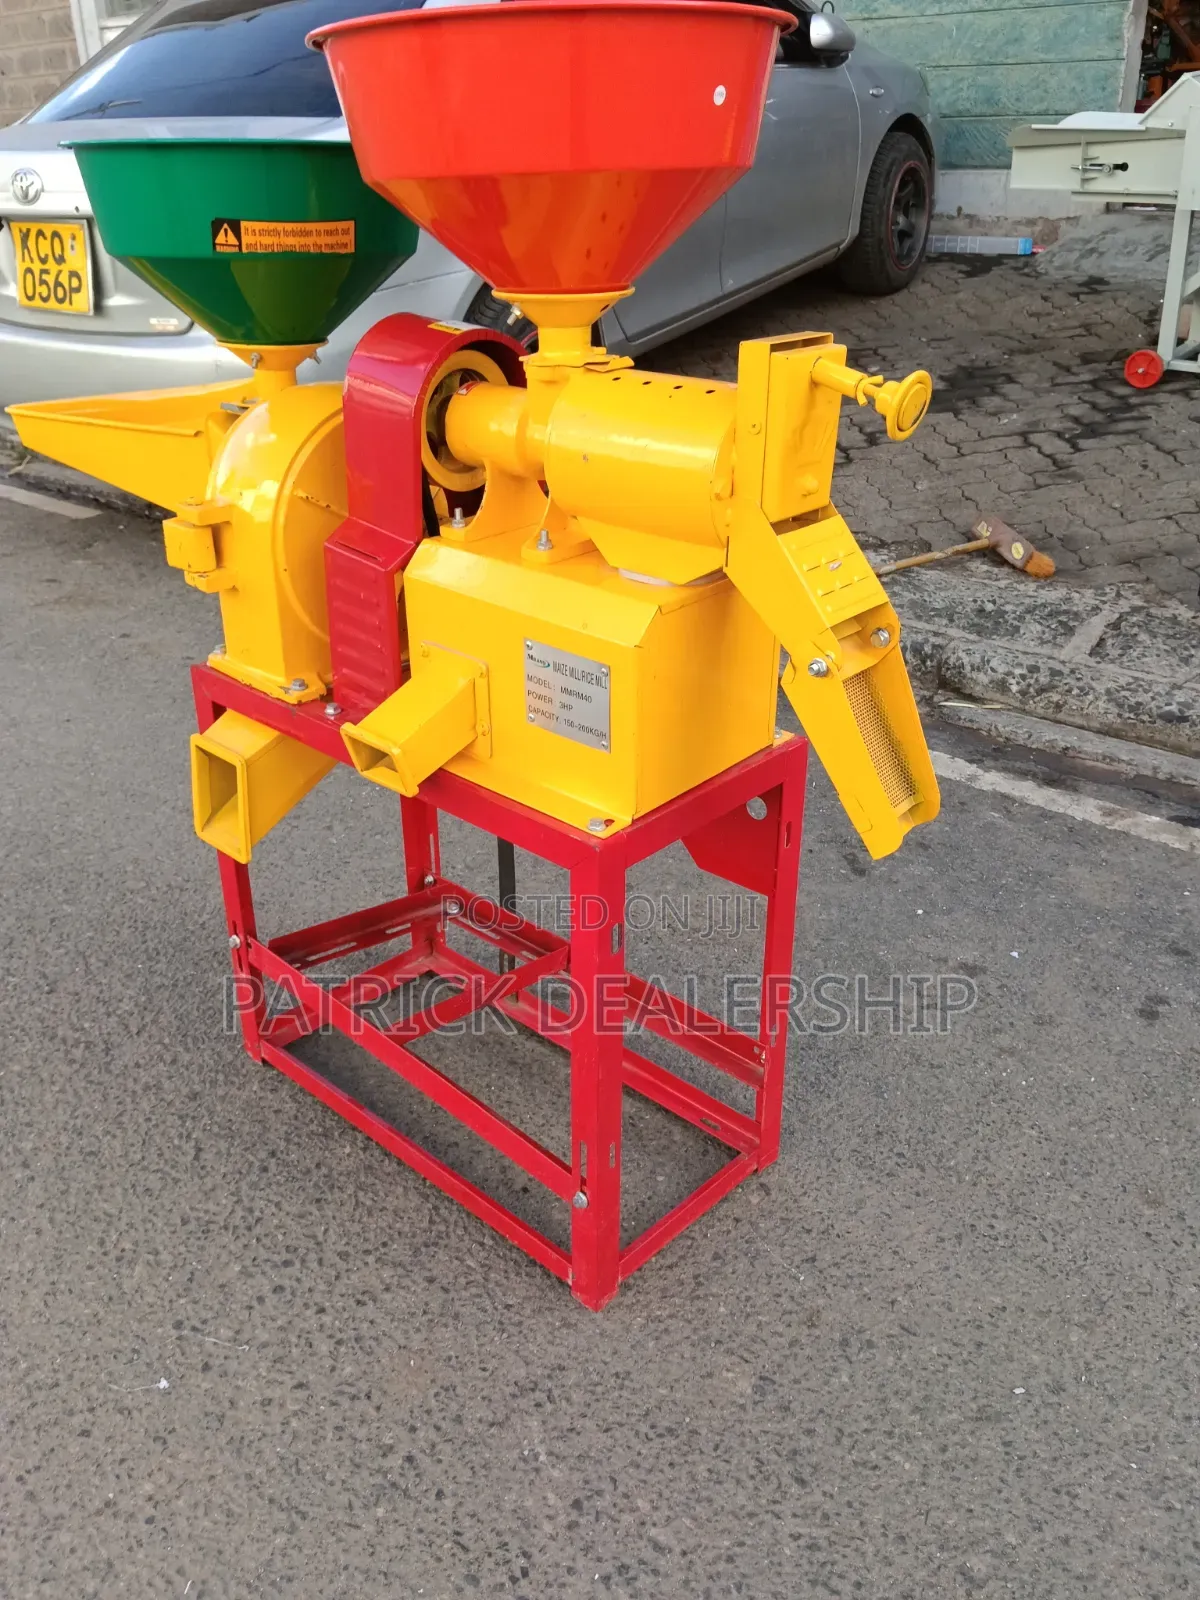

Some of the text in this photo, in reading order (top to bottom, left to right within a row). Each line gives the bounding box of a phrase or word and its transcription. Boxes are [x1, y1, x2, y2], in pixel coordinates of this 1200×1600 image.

[244, 225, 351, 240] It is strictly forbidden to reach out
[18, 227, 67, 266] KCQ
[245, 241, 258, 251] and
[259, 241, 274, 251] hard
[276, 241, 297, 252] things
[298, 241, 311, 251] into
[312, 240, 323, 251] the
[22, 267, 83, 307] 056P
[552, 660, 568, 677] MAIZE
[595, 674, 608, 690] MILL
[560, 685, 593, 704] MMRM40
[558, 700, 574, 712] 3HP
[563, 717, 607, 740] 150-200KG/H
